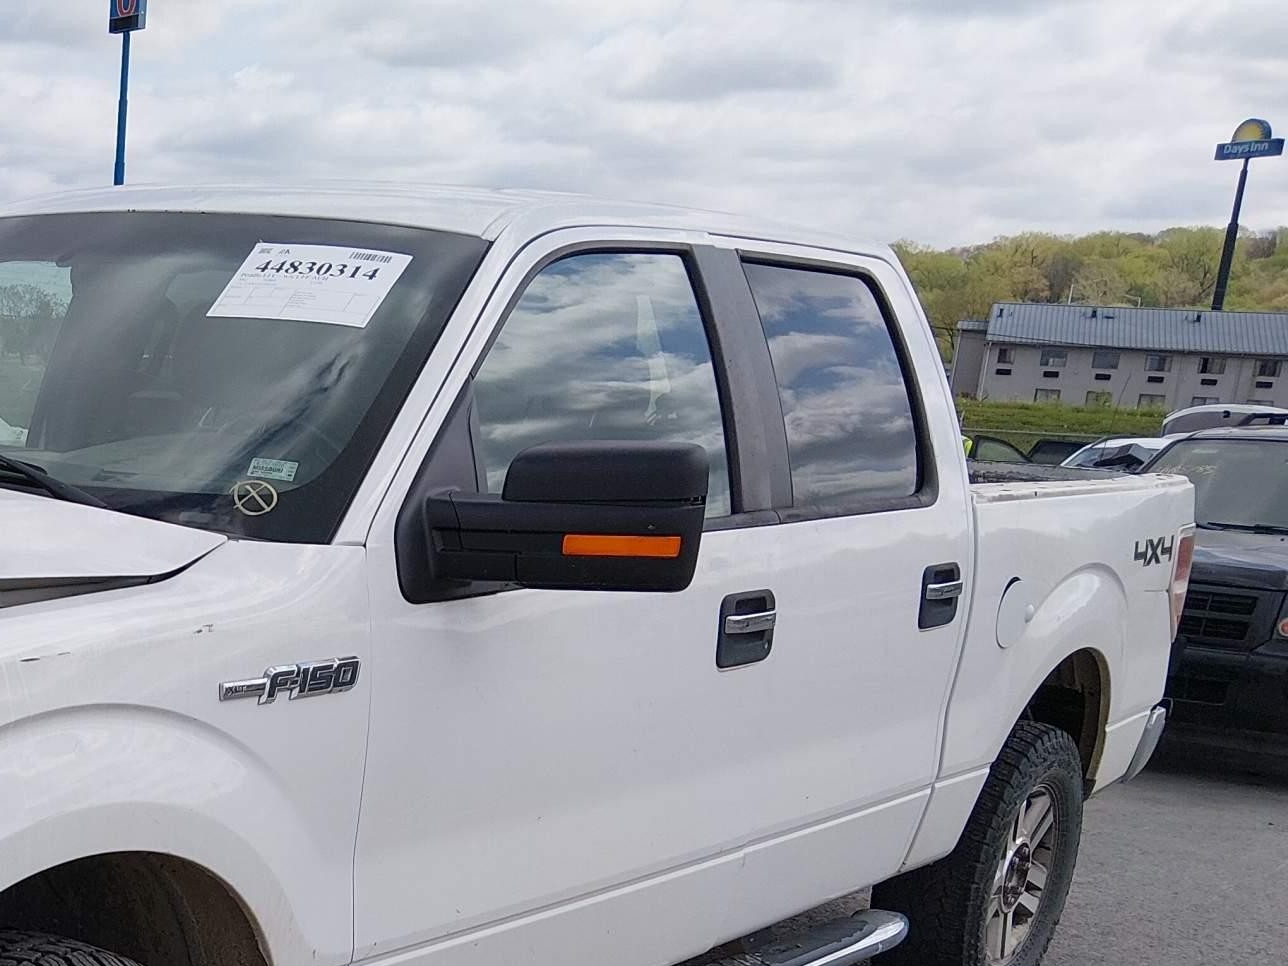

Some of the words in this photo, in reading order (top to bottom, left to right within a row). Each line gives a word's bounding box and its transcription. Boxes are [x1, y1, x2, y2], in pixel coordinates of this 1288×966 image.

[1223, 143, 1249, 154] Days
[1250, 142, 1268, 152] Inn
[255, 259, 380, 280] 44830314
[225, 685, 247, 696] XLT
